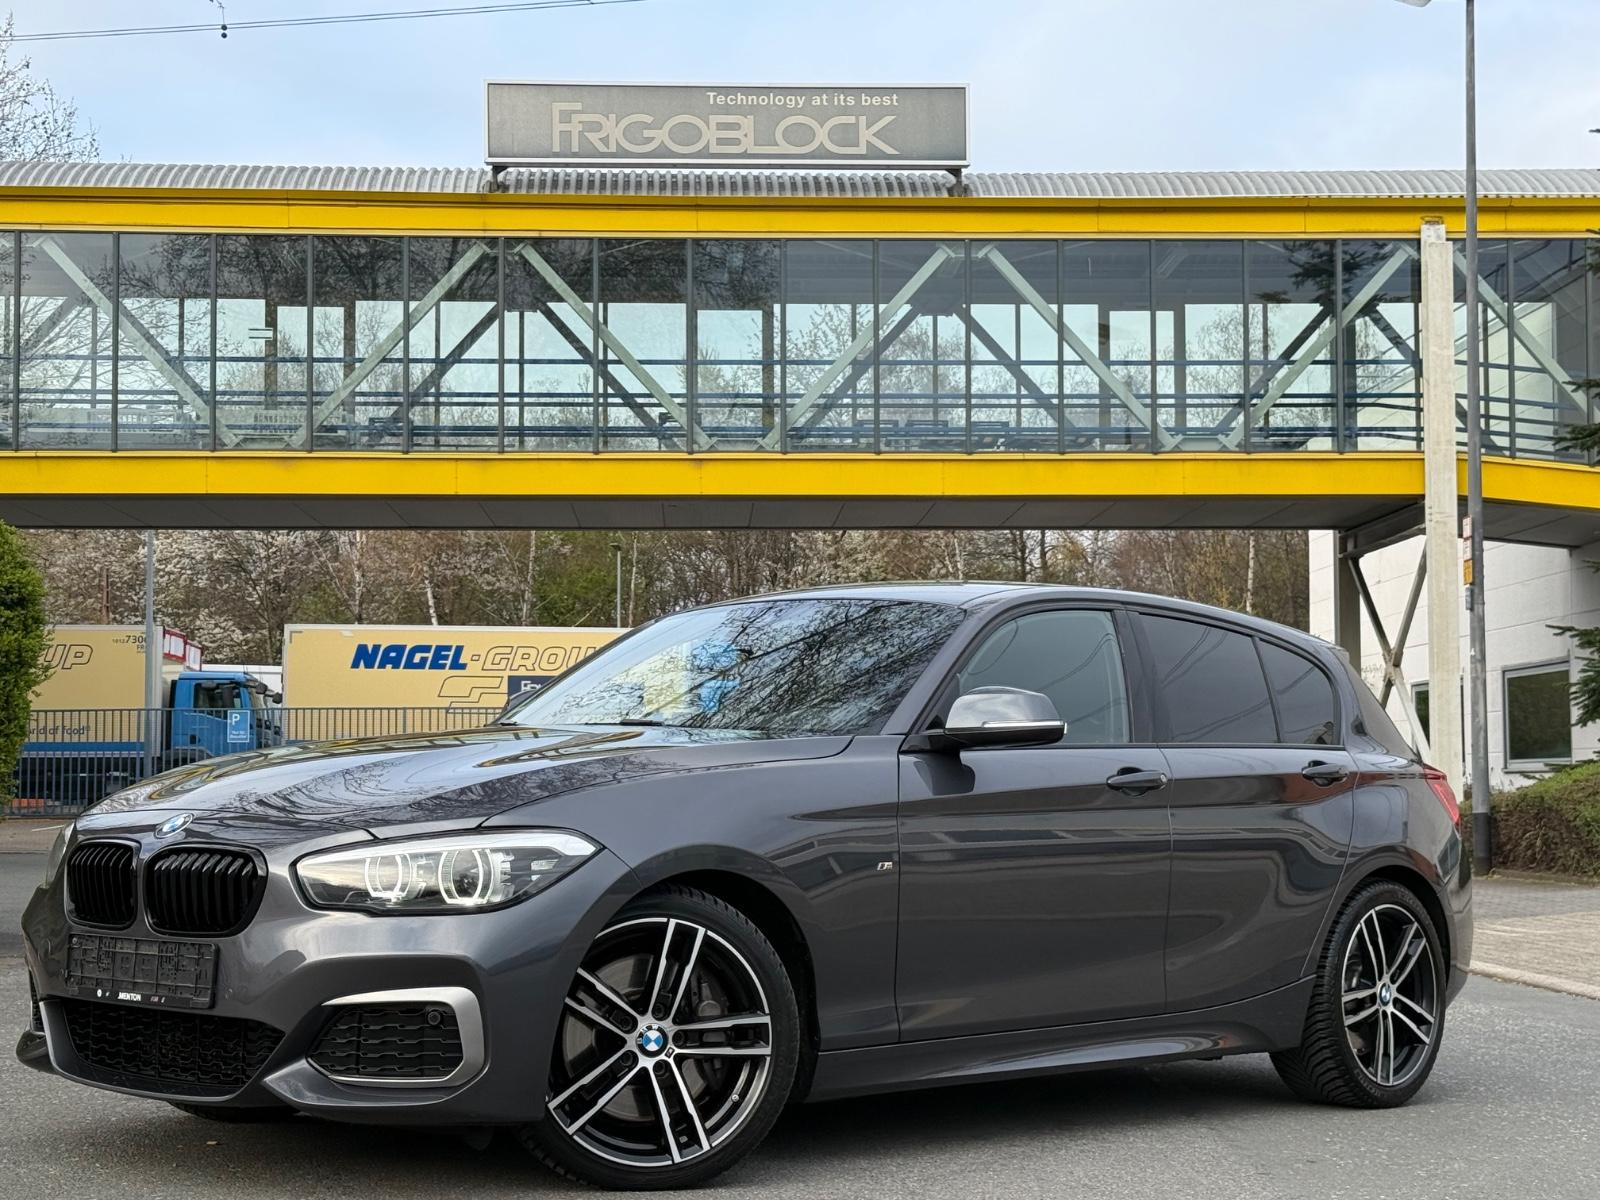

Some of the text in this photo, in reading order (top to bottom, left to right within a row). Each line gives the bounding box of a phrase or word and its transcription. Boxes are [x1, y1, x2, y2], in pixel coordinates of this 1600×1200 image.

[706, 92, 899, 108] Technology at its best
[552, 102, 900, 155] FRIGOBLOCK
[232, 713, 240, 725] P
